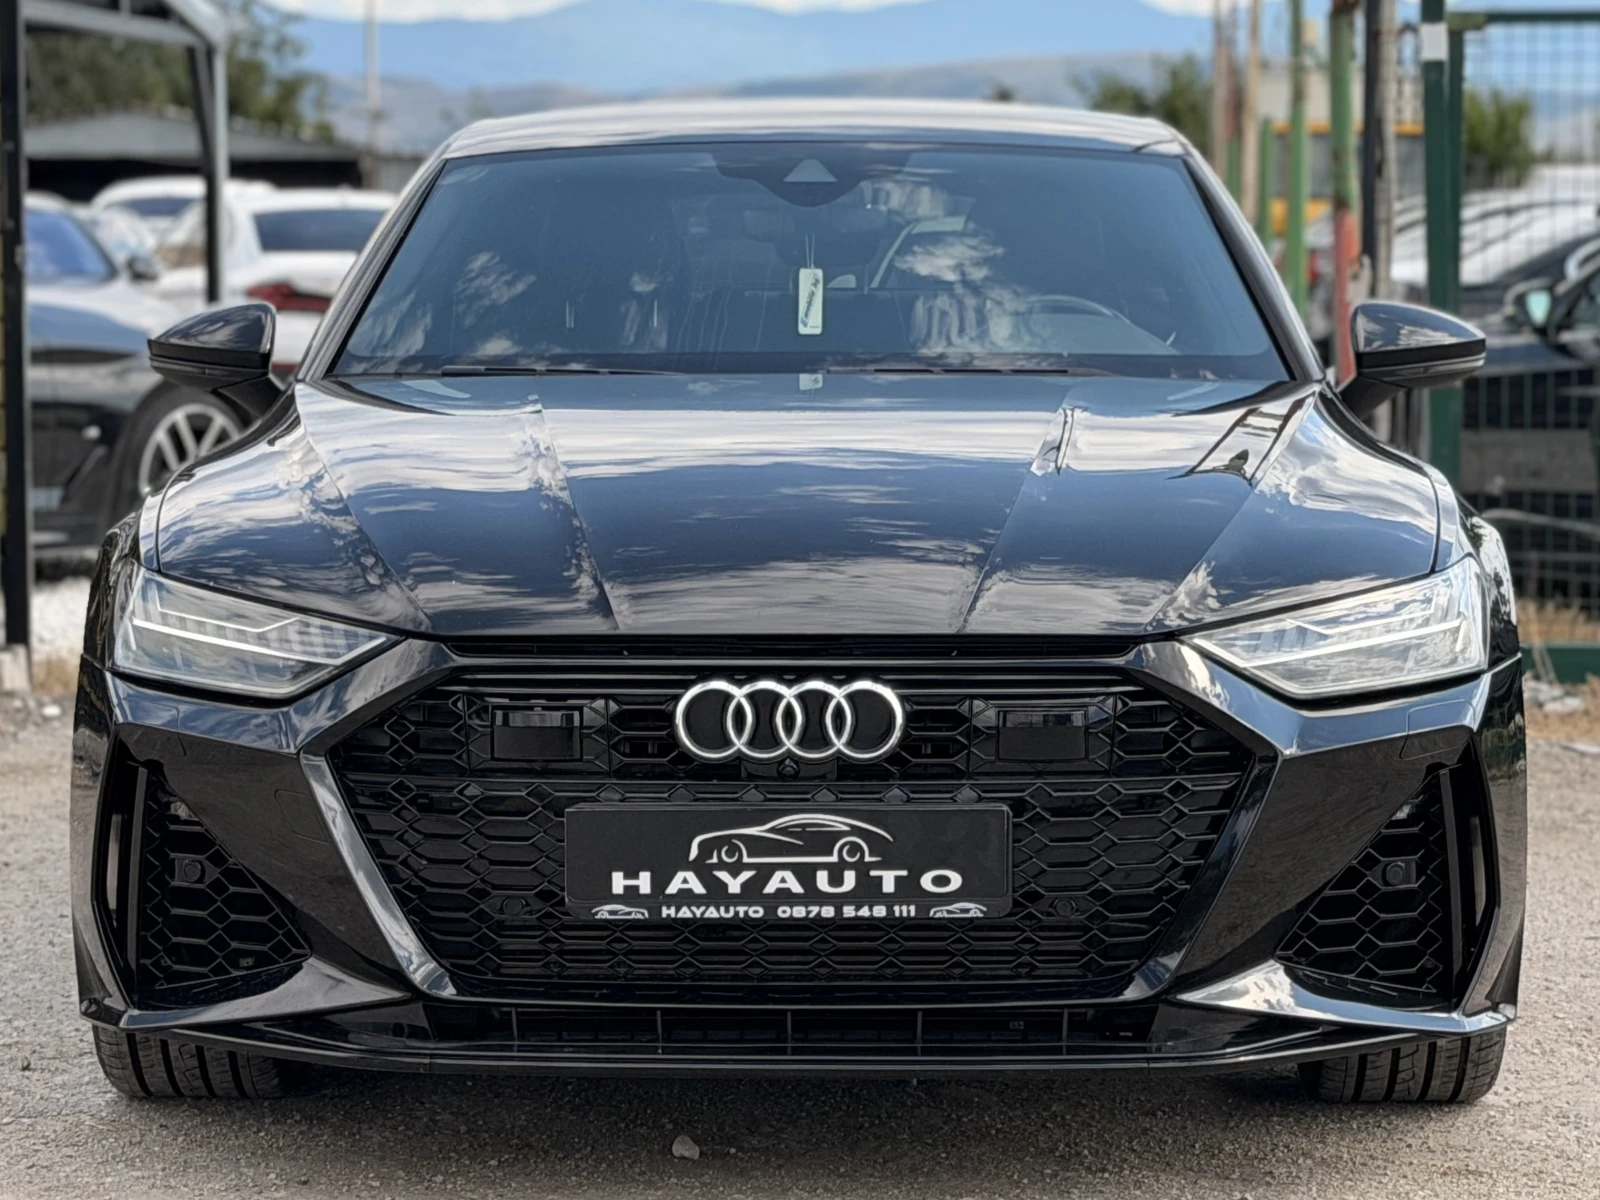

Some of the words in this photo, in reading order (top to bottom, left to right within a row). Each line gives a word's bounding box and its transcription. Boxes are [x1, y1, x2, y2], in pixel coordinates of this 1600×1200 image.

[611, 869, 963, 895] HAYAUTO
[661, 905, 765, 919] HAYAUTO
[776, 905, 836, 918] 0878
[842, 905, 888, 918] 548
[892, 904, 916, 918] 111
